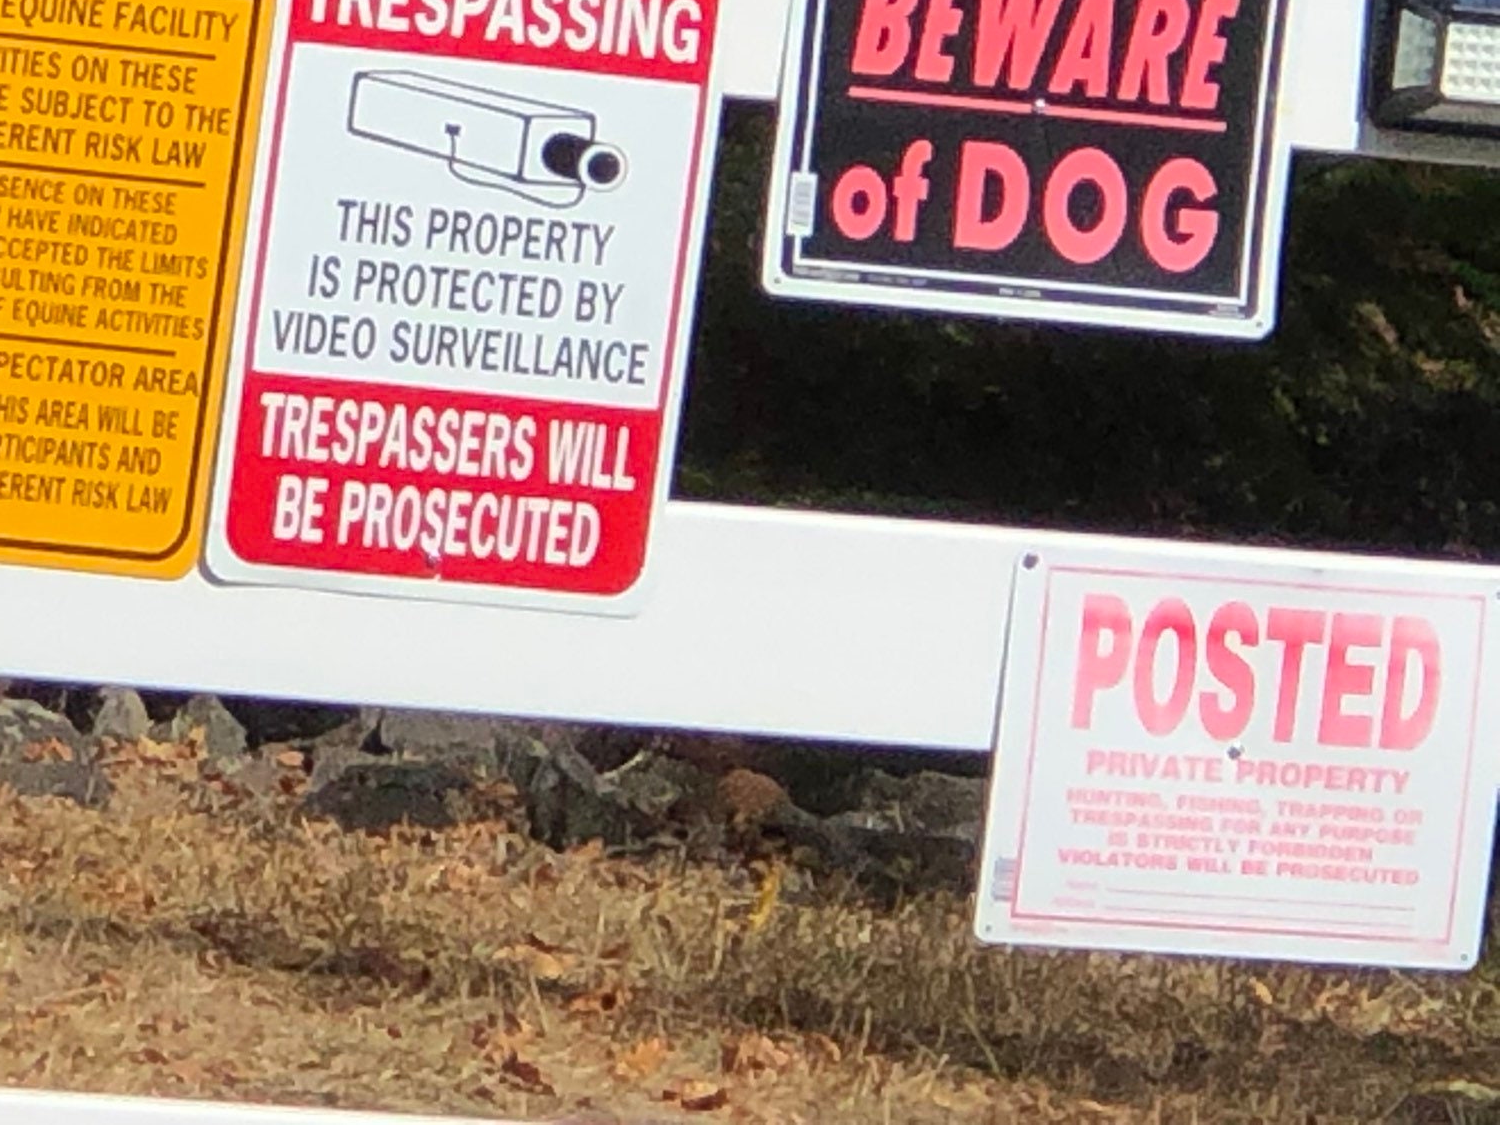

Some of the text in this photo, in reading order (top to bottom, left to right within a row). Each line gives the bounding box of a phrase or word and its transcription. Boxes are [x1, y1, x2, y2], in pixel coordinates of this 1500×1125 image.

[113, 1, 239, 43] FACILITY
[71, 54, 109, 85] ON
[119, 58, 198, 95] THESE
[19, 86, 134, 125] SUBJECT
[143, 99, 175, 130] TO
[184, 103, 232, 136] THE
[84, 130, 143, 163] RISK
[151, 137, 207, 169] LAW
[73, 182, 105, 208] ON
[112, 187, 177, 216] THESE
[831, 139, 1219, 273] of DOG
[6, 206, 61, 234] HAVE
[67, 213, 178, 246] INDICATED
[337, 199, 615, 266] THIS PROPERTY
[96, 246, 135, 273] THE
[140, 251, 209, 280] LIMITS
[80, 275, 141, 303] FROM
[149, 282, 189, 309] THE
[308, 254, 625, 325] IS PROTECTED BY
[12, 297, 89, 329] EQUINE
[94, 307, 204, 341] ACTIVITIES
[273, 310, 649, 385] VIDEO SURVEILLANCE
[132, 365, 199, 397] AREA
[34, 398, 89, 431] AREA
[97, 404, 144, 437] WILL
[151, 409, 180, 441] BE
[115, 445, 162, 477] AND
[260, 392, 636, 491] TRESPASSERS WILL
[71, 477, 120, 510] RISK
[126, 483, 172, 515] LAW
[273, 474, 600, 567] BE PROSECUTED
[1071, 593, 1441, 751] POSTED
[1086, 749, 1410, 794] PRIVATE PROPERTY
[1136, 832, 1240, 854] STRICTLY
[1269, 821, 1310, 837] ANY
[1058, 848, 1419, 885] VIOLATORS WILL BE PROSECUTED
